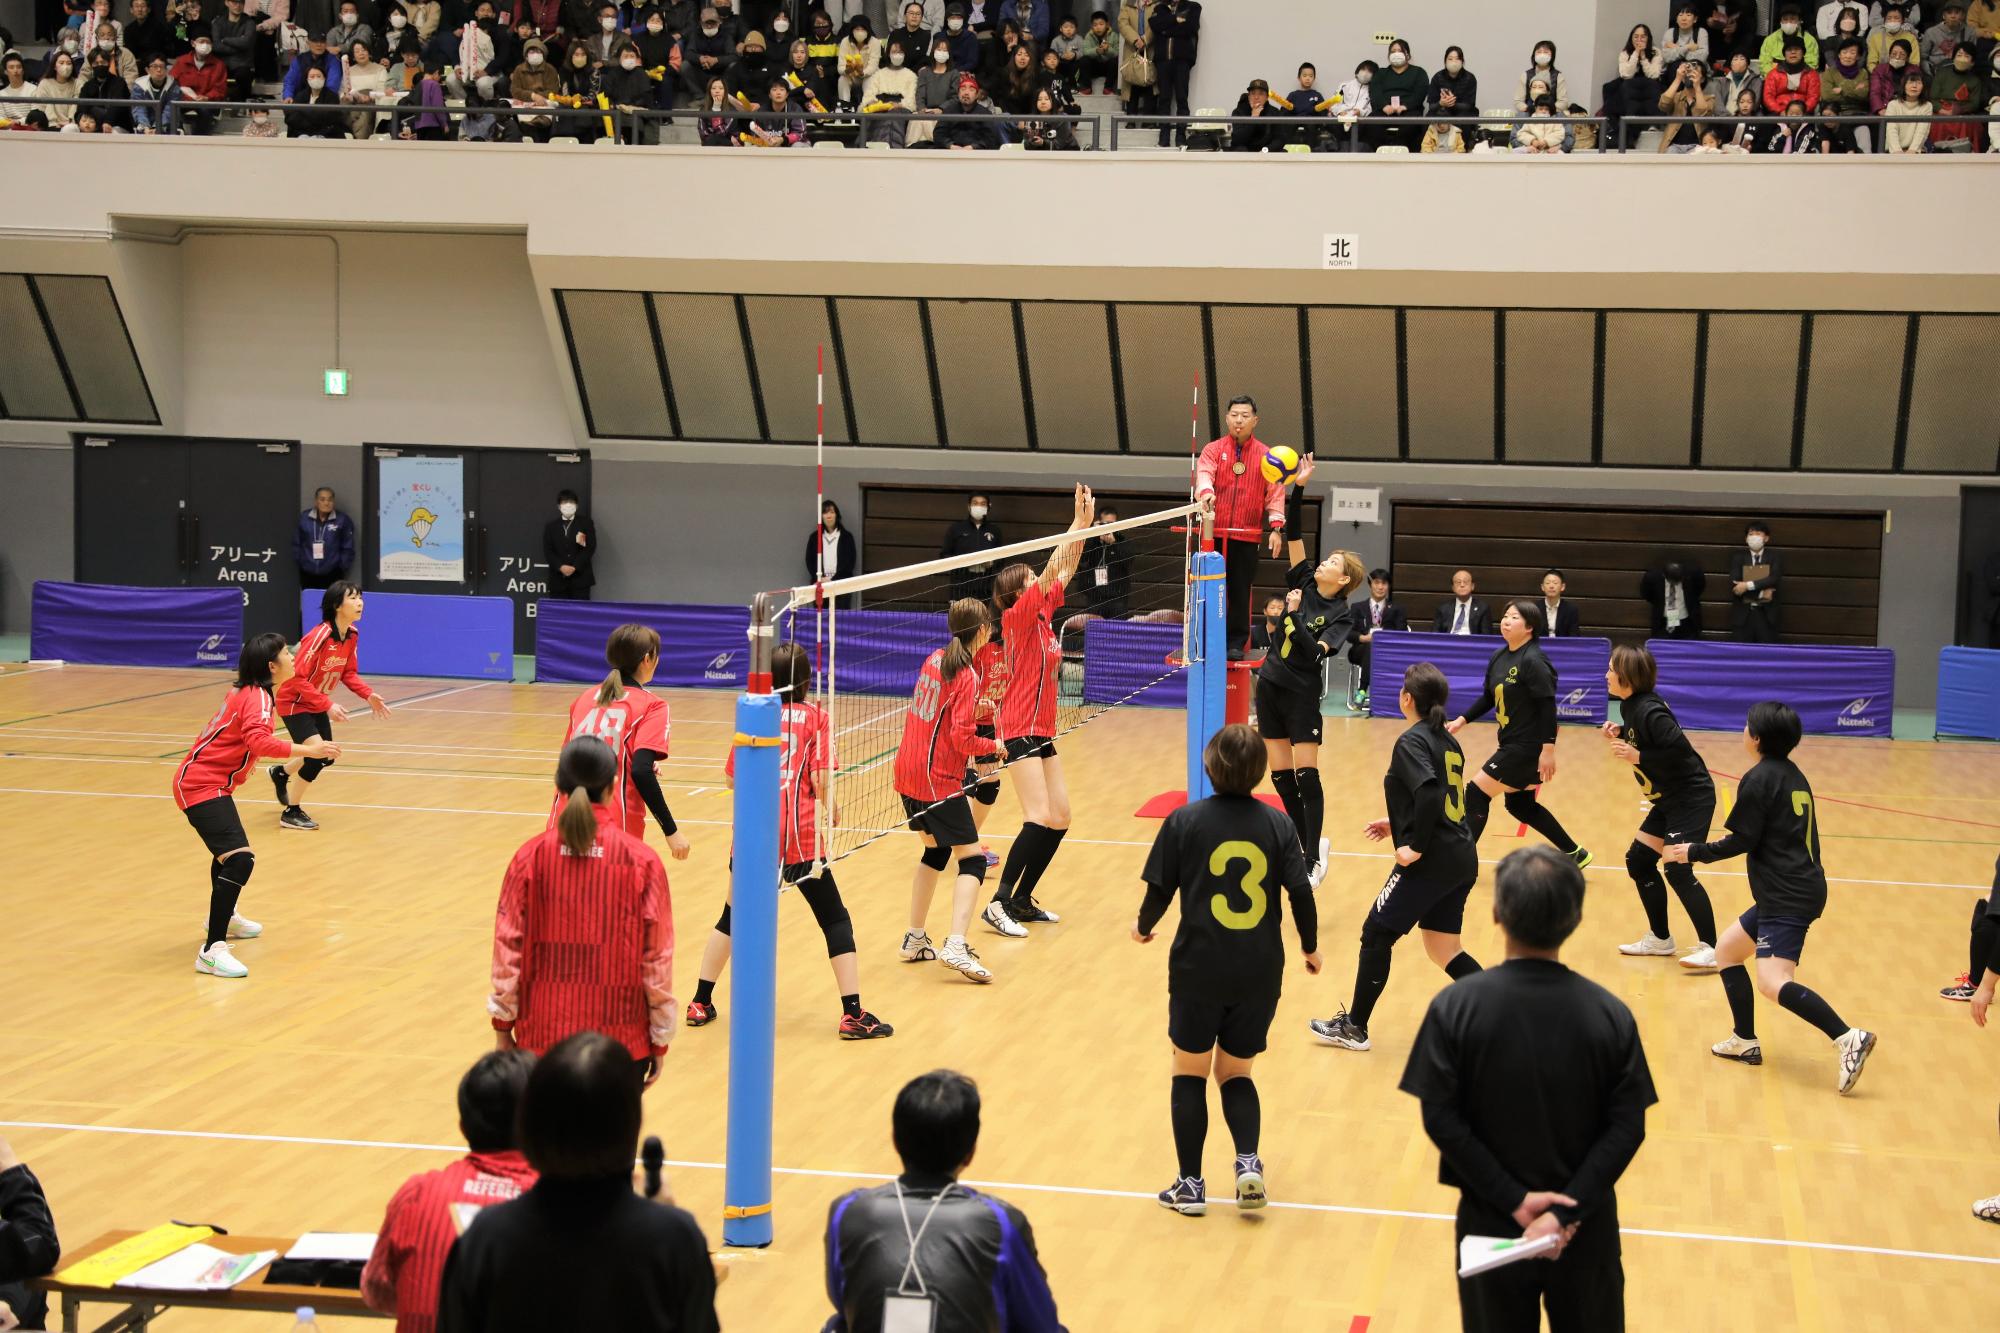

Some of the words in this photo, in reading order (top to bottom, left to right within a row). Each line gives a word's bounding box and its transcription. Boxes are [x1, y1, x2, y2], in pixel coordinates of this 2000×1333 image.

[1330, 239, 1350, 258] 北
[210, 546, 277, 563] アリーナ
[499, 556, 550, 573] アリー
[217, 566, 269, 583] Arena
[506, 577, 549, 593] Aren
[526, 602, 537, 618] B
[318, 671, 341, 695] 10
[704, 670, 737, 680] Nittaku
[1494, 683, 1510, 730] 4
[1837, 716, 1875, 727] Nittaku
[572, 707, 627, 756] 48
[1444, 750, 1466, 825] 5
[1791, 790, 1814, 861] 7
[1209, 840, 1268, 930] 3
